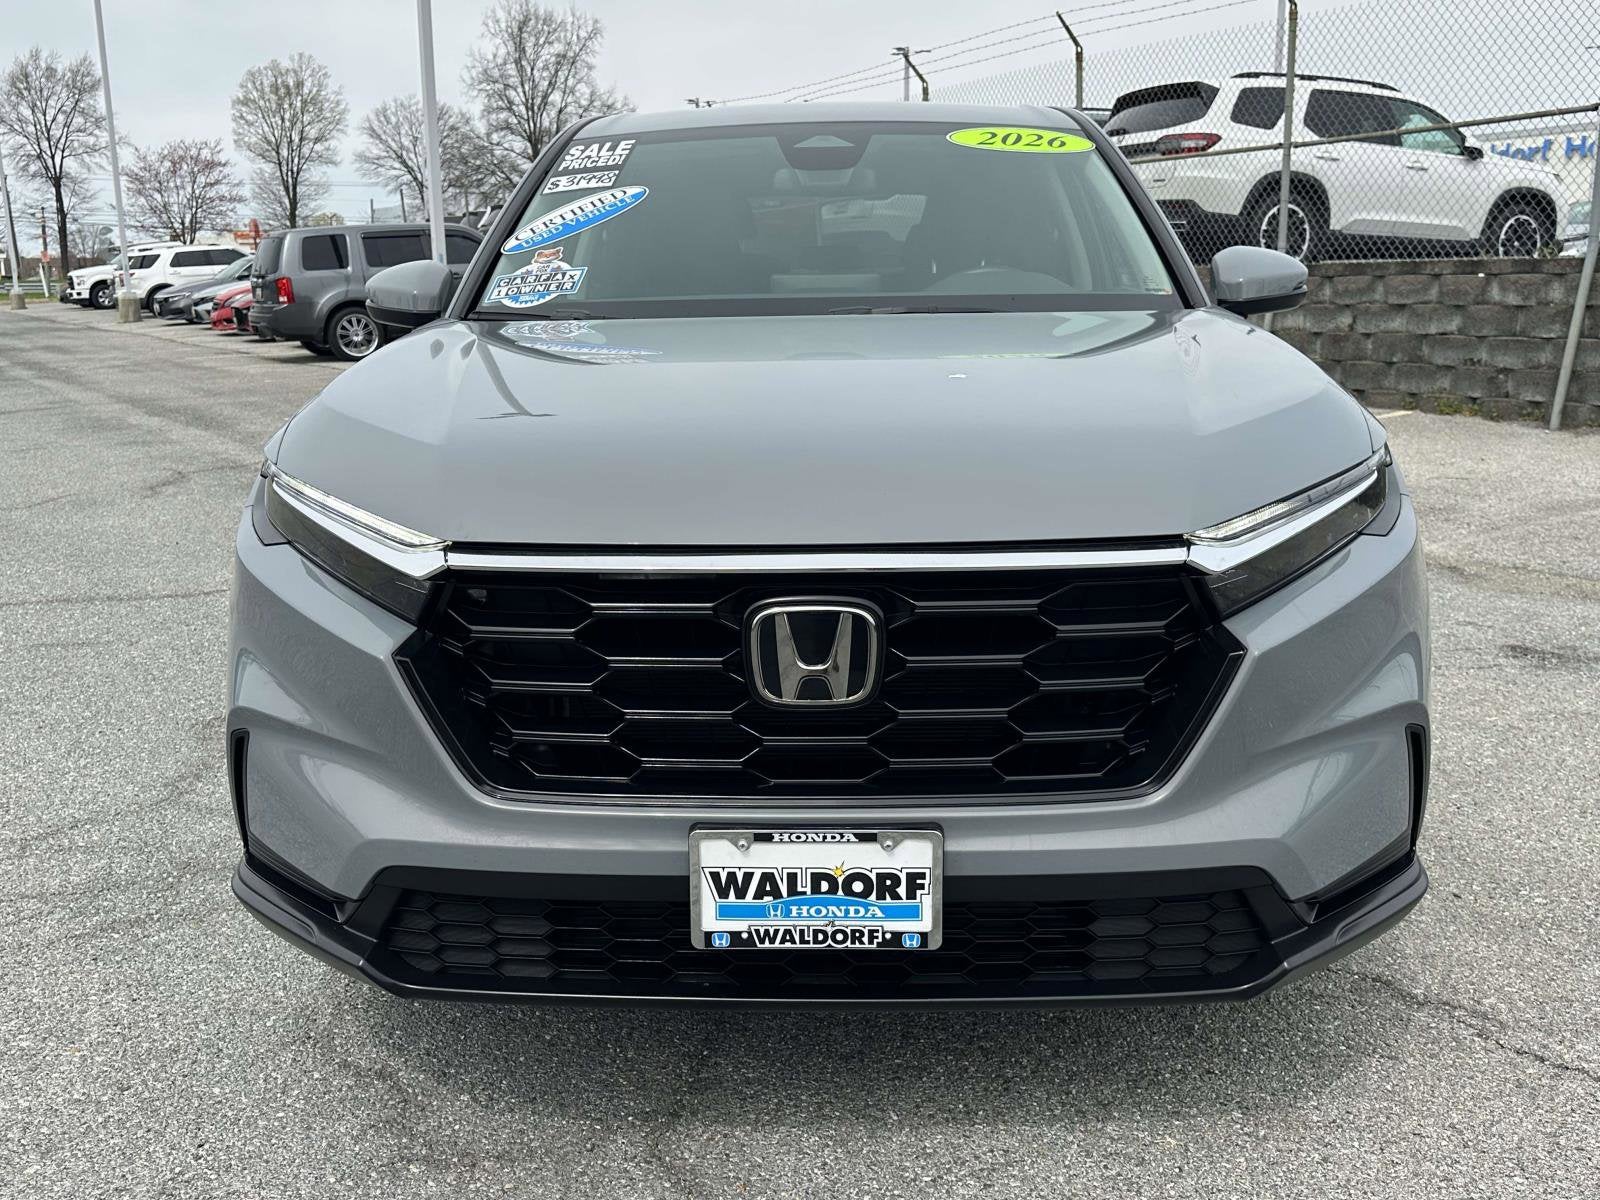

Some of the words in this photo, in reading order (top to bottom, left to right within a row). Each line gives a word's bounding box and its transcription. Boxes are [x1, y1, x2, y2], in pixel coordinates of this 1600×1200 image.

[977, 131, 1069, 149] 2026
[564, 139, 636, 161] SALE
[557, 154, 627, 171] PRICED!
[514, 189, 627, 241] CERTIFIED
[521, 225, 563, 248] USED
[566, 195, 635, 226] VEHICLE
[498, 272, 577, 288] CARFAX
[507, 282, 574, 296] OWNER
[772, 833, 858, 842] HONDA
[706, 869, 928, 901] WALDORF
[789, 904, 885, 918] HONDA
[753, 928, 881, 946] WALDORF
